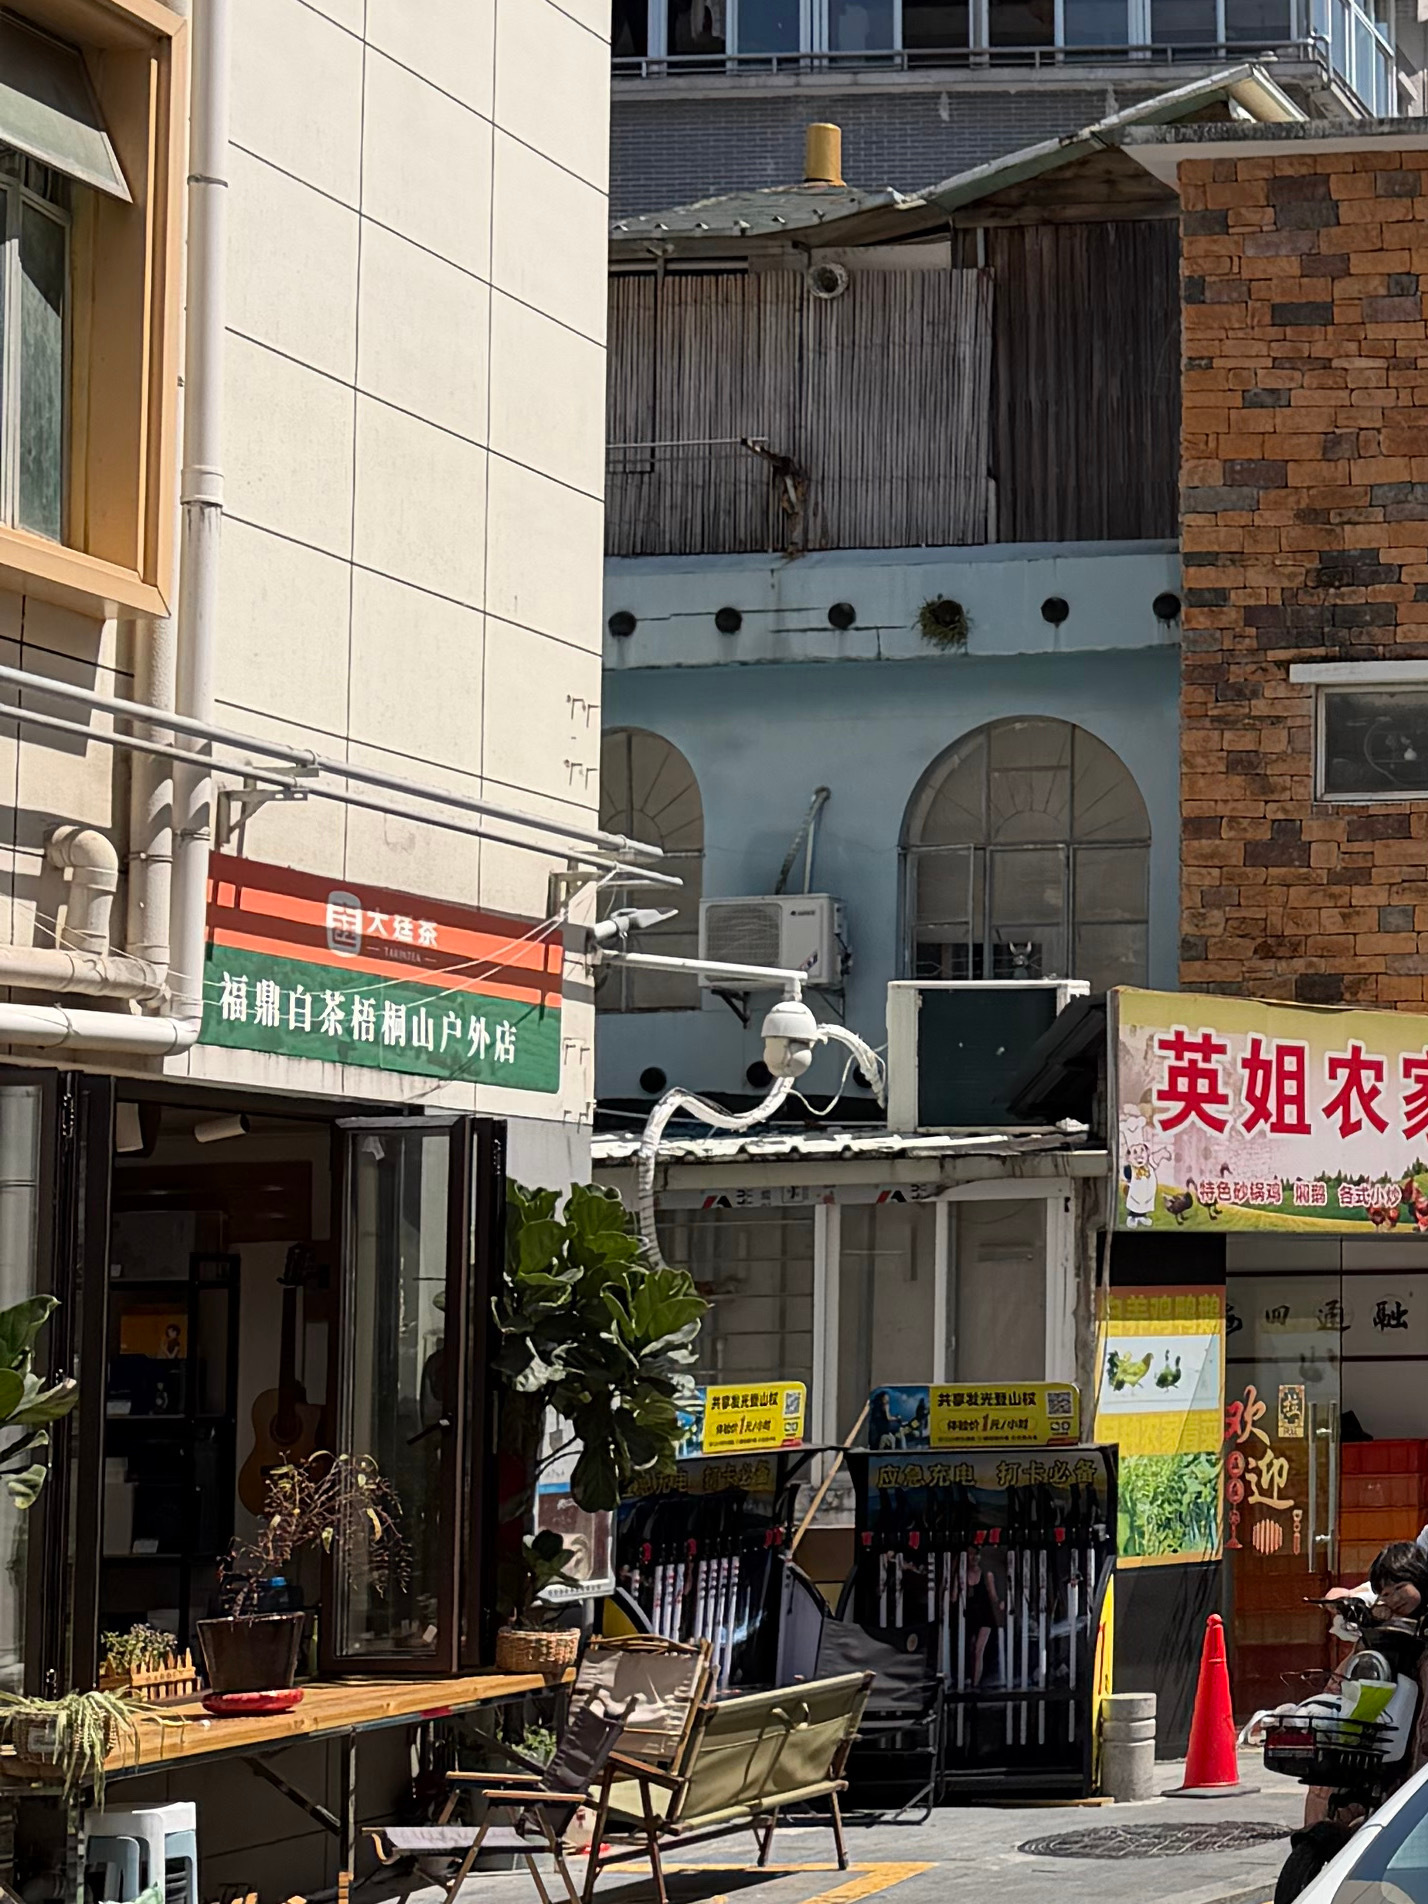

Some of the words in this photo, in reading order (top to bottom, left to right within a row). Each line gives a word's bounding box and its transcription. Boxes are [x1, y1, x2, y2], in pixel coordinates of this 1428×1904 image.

[220, 970, 517, 1064] 福鼎白茶梧桐山户外店
[1198, 1181, 1283, 1205] 特色砂锅鸡
[1338, 1183, 1402, 1207] 各式小炒
[947, 1413, 1030, 1433] 体验价1元/小时
[1225, 1384, 1295, 1510] 欢迎
[876, 1462, 978, 1489] 应急充电
[996, 1458, 1098, 1487] 打卡必备
